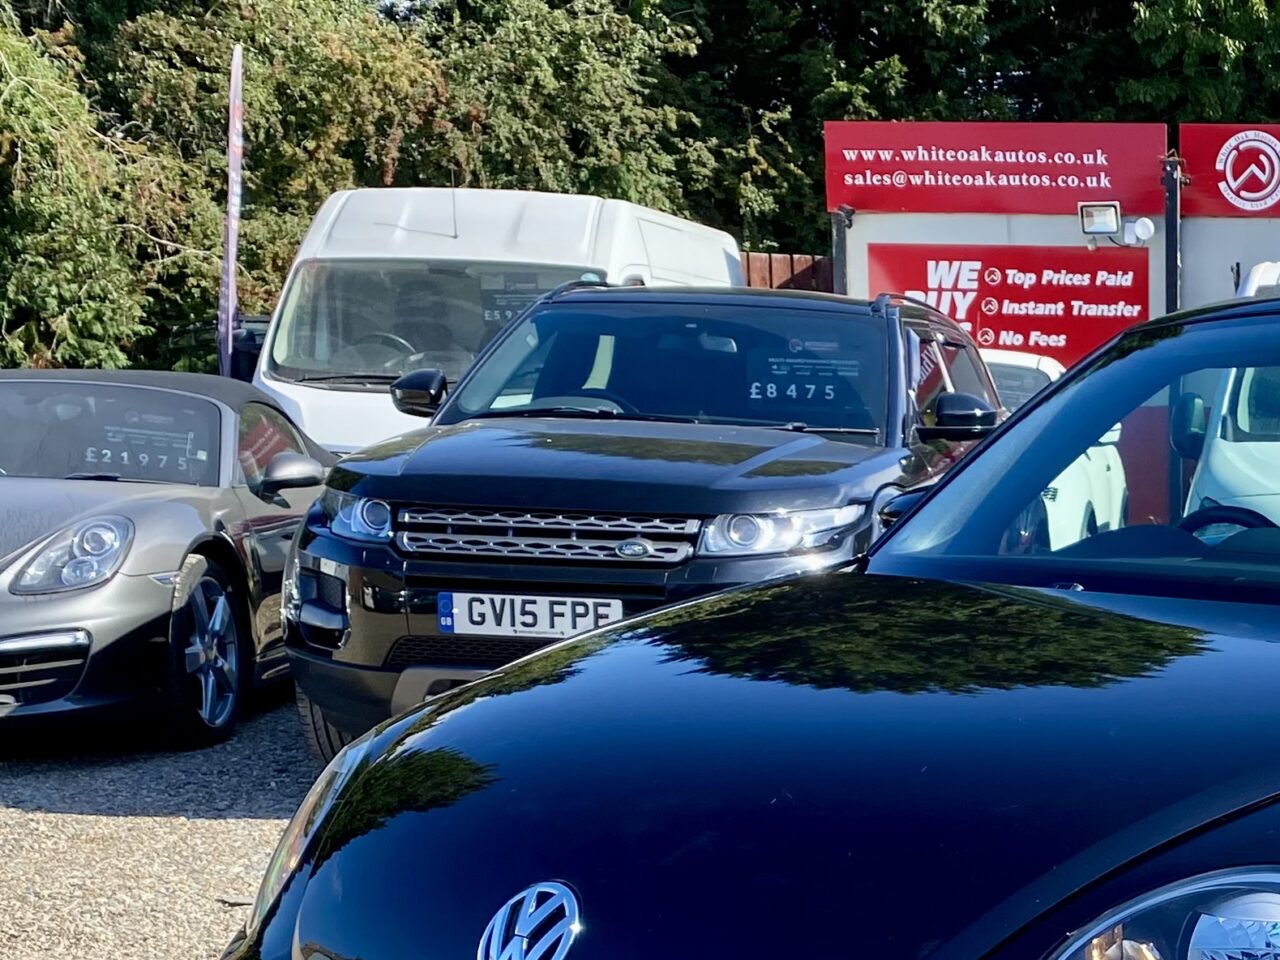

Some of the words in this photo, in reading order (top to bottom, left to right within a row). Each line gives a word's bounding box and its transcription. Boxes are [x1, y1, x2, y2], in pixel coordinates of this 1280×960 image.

[842, 145, 1109, 166] www.whiteoakautos.co.uk
[843, 169, 1112, 189] sales@whiteoakautos.co.uk
[926, 260, 982, 289] WE
[1005, 268, 1037, 289] Top
[1041, 269, 1090, 287] Prices
[1095, 270, 1134, 287] Paid
[1001, 299, 1064, 316] Instant
[1070, 300, 1142, 318] Transfer
[998, 330, 1024, 347] No
[1028, 331, 1067, 347] Fees
[749, 381, 836, 400] £8475
[84, 446, 188, 471] £21975
[467, 596, 539, 629] GV15
